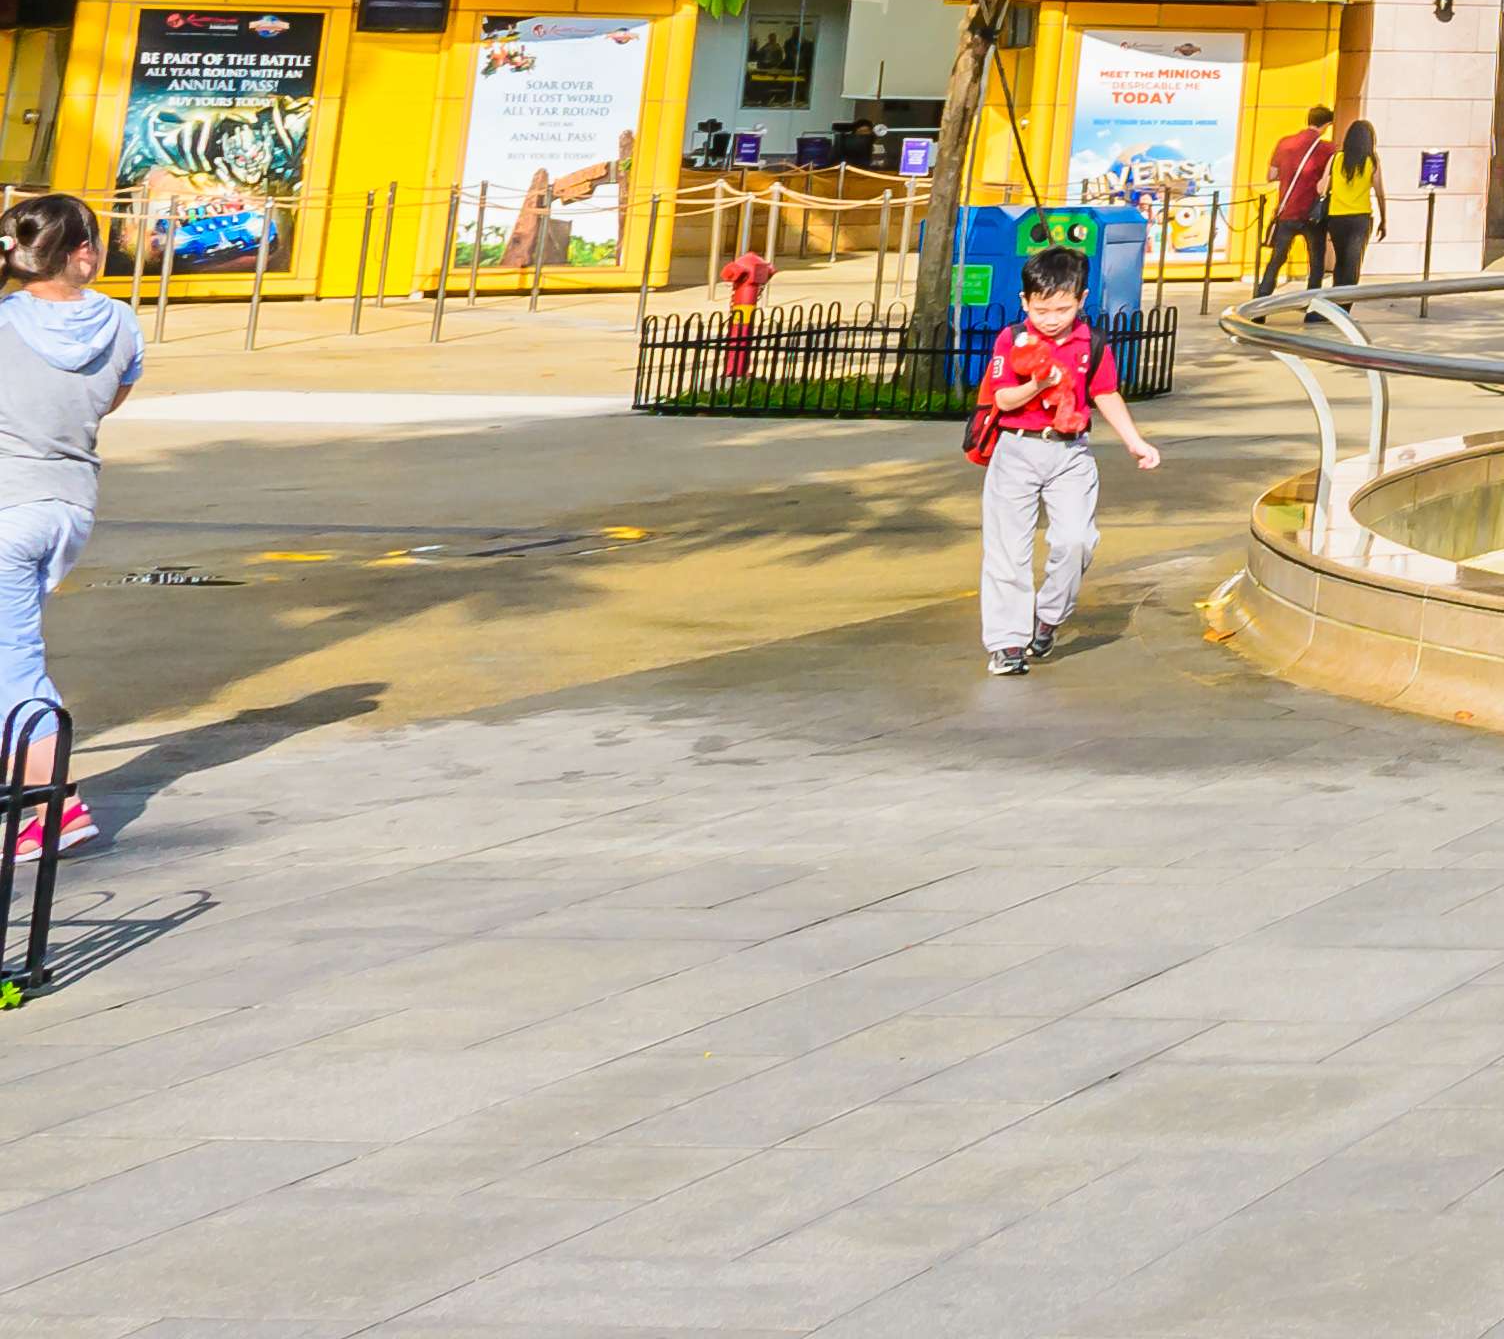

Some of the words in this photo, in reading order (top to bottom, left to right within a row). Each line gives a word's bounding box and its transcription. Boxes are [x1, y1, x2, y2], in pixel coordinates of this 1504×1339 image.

[140, 52, 160, 65] BE
[163, 52, 202, 65] PART
[202, 53, 225, 66] OF
[227, 54, 257, 66] THE
[260, 54, 311, 67] BATTLE
[145, 67, 168, 77] ALL
[170, 67, 200, 77] YEAR
[202, 68, 249, 78] ROUND
[250, 68, 284, 78] WITH
[284, 69, 303, 79] AN
[1100, 70, 1129, 79] MEET
[1134, 70, 1155, 79] THE
[1157, 69, 1221, 80] MINIONS
[167, 79, 236, 92] ANNUAL
[240, 79, 279, 92] PASS!
[526, 80, 558, 91] SOAR
[561, 80, 594, 91] OVER
[1111, 81, 1181, 90] DESPICABLE
[1184, 82, 1200, 90] ME
[168, 96, 194, 107] BUY
[194, 96, 234, 107] YOURS
[504, 92, 528, 103] THE
[532, 93, 563, 103] LOST
[567, 93, 613, 104] WORLD
[1111, 91, 1176, 104] TODAY
[502, 106, 524, 116] ALL
[528, 106, 559, 116] YEAR
[562, 106, 610, 116] ROUND
[510, 132, 563, 142] ANNUAL
